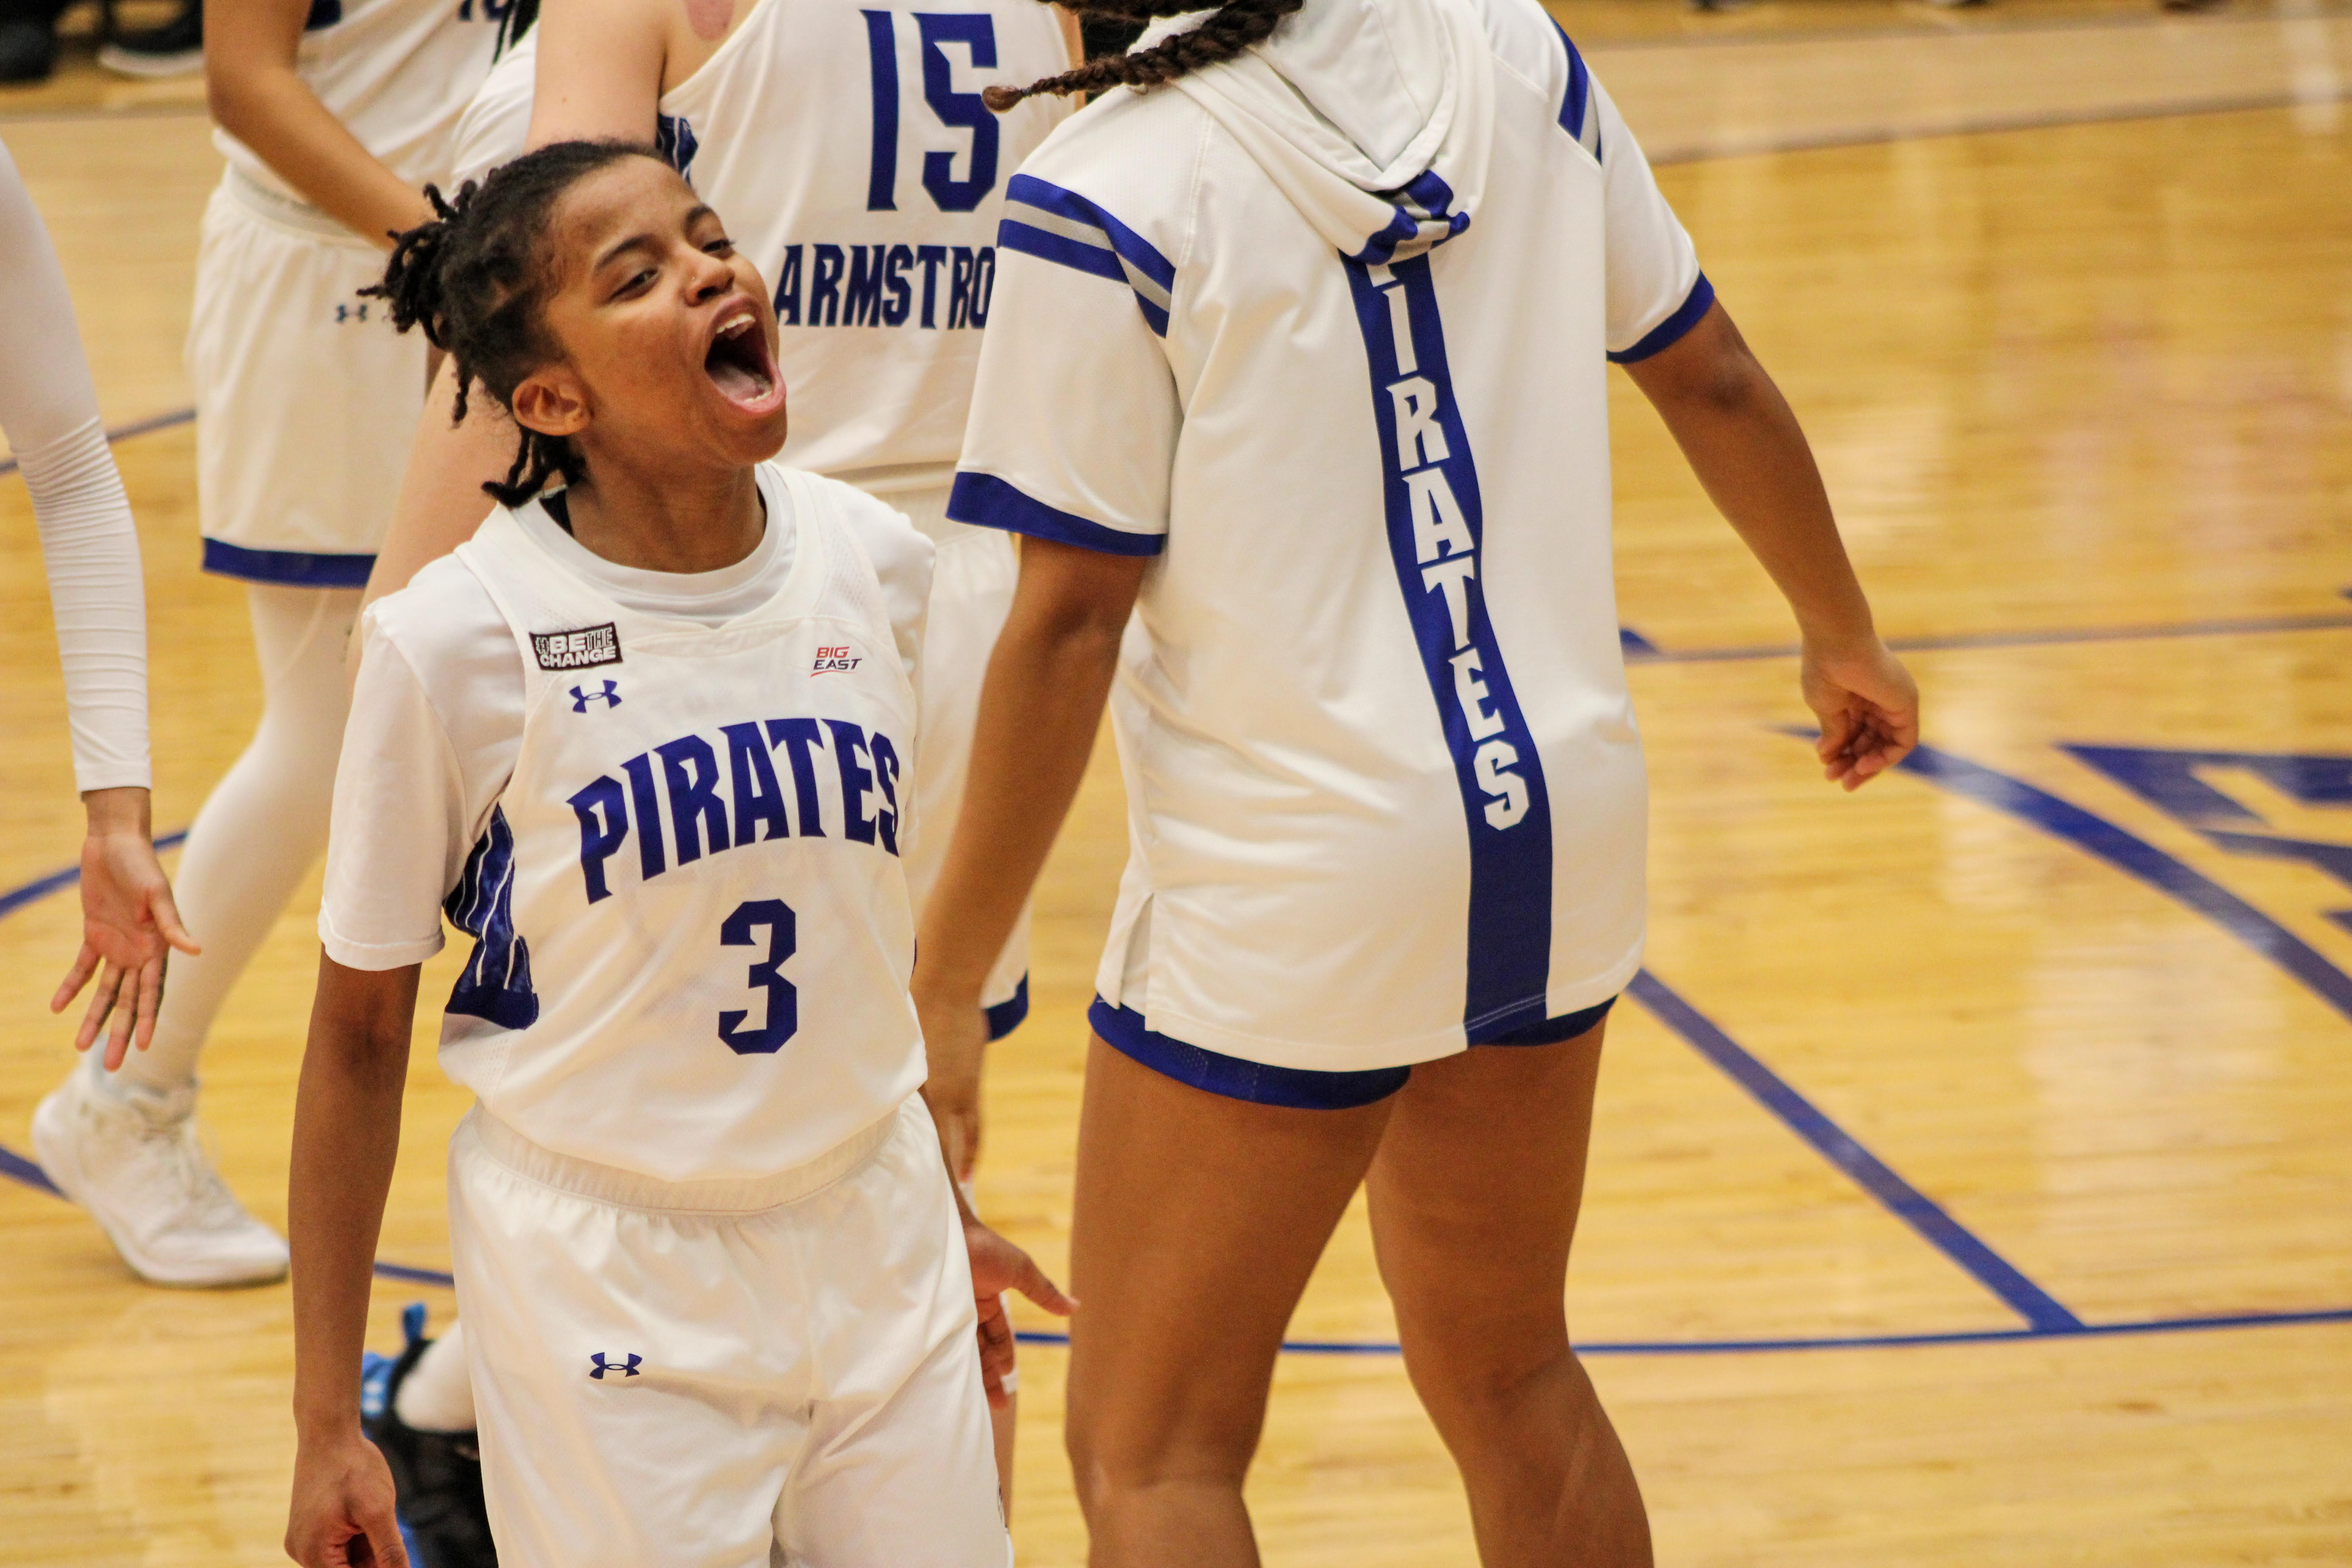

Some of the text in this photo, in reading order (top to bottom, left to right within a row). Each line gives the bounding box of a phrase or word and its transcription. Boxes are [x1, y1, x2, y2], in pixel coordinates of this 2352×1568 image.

[860, 10, 999, 212] 15
[540, 646, 616, 667] CHANGE
[813, 658, 862, 670] EAST
[817, 646, 850, 658] BIG
[566, 718, 899, 905] PIRATES
[718, 899, 797, 1055] 3
